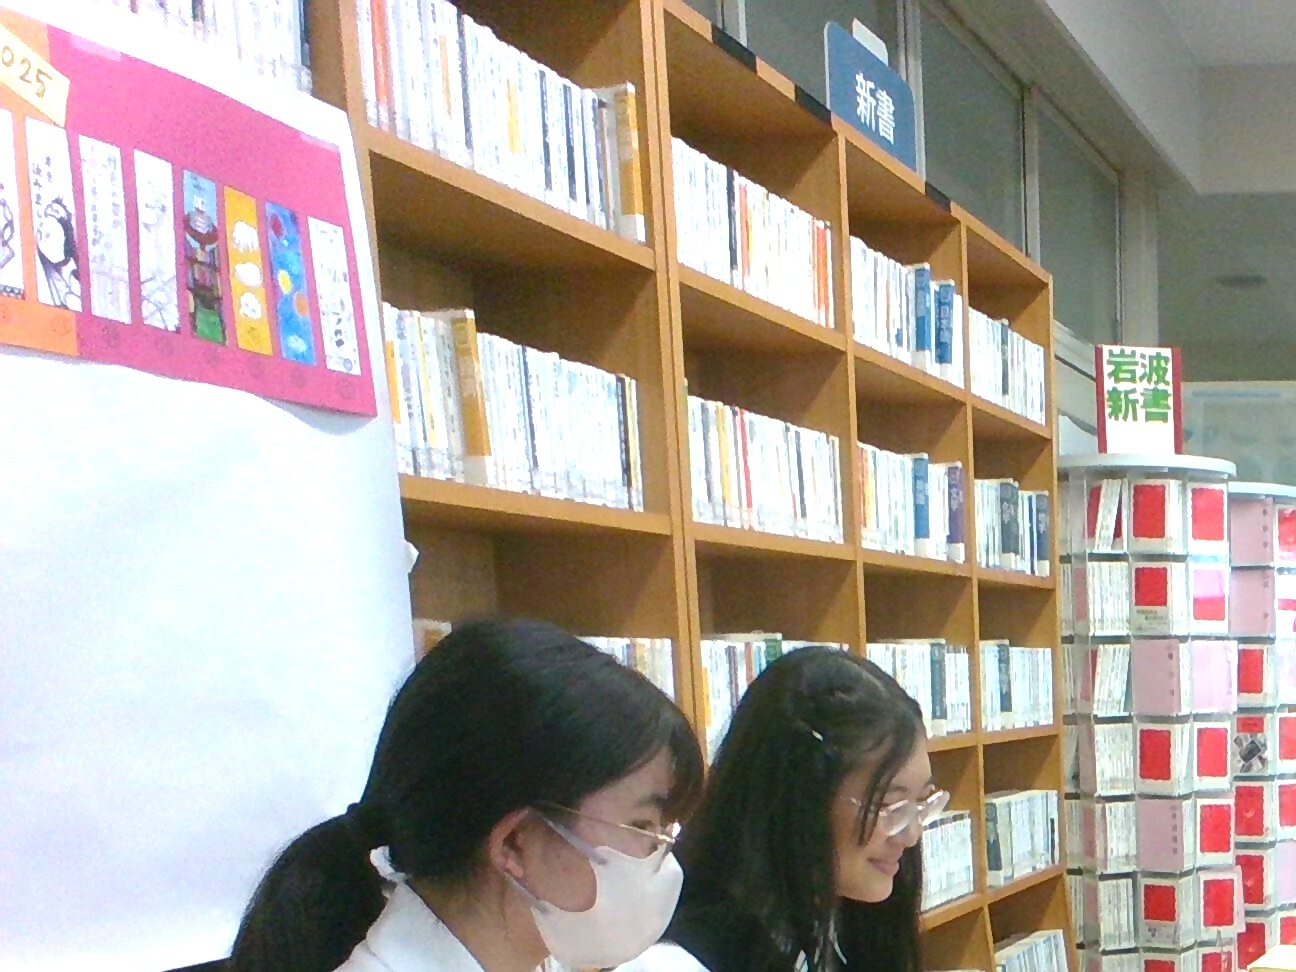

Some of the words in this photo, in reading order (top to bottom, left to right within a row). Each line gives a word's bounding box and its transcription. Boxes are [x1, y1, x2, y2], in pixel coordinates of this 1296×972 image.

[855, 69, 895, 145] 新書
[1107, 348, 1170, 386] 岩波
[1107, 386, 1172, 423] 新書
